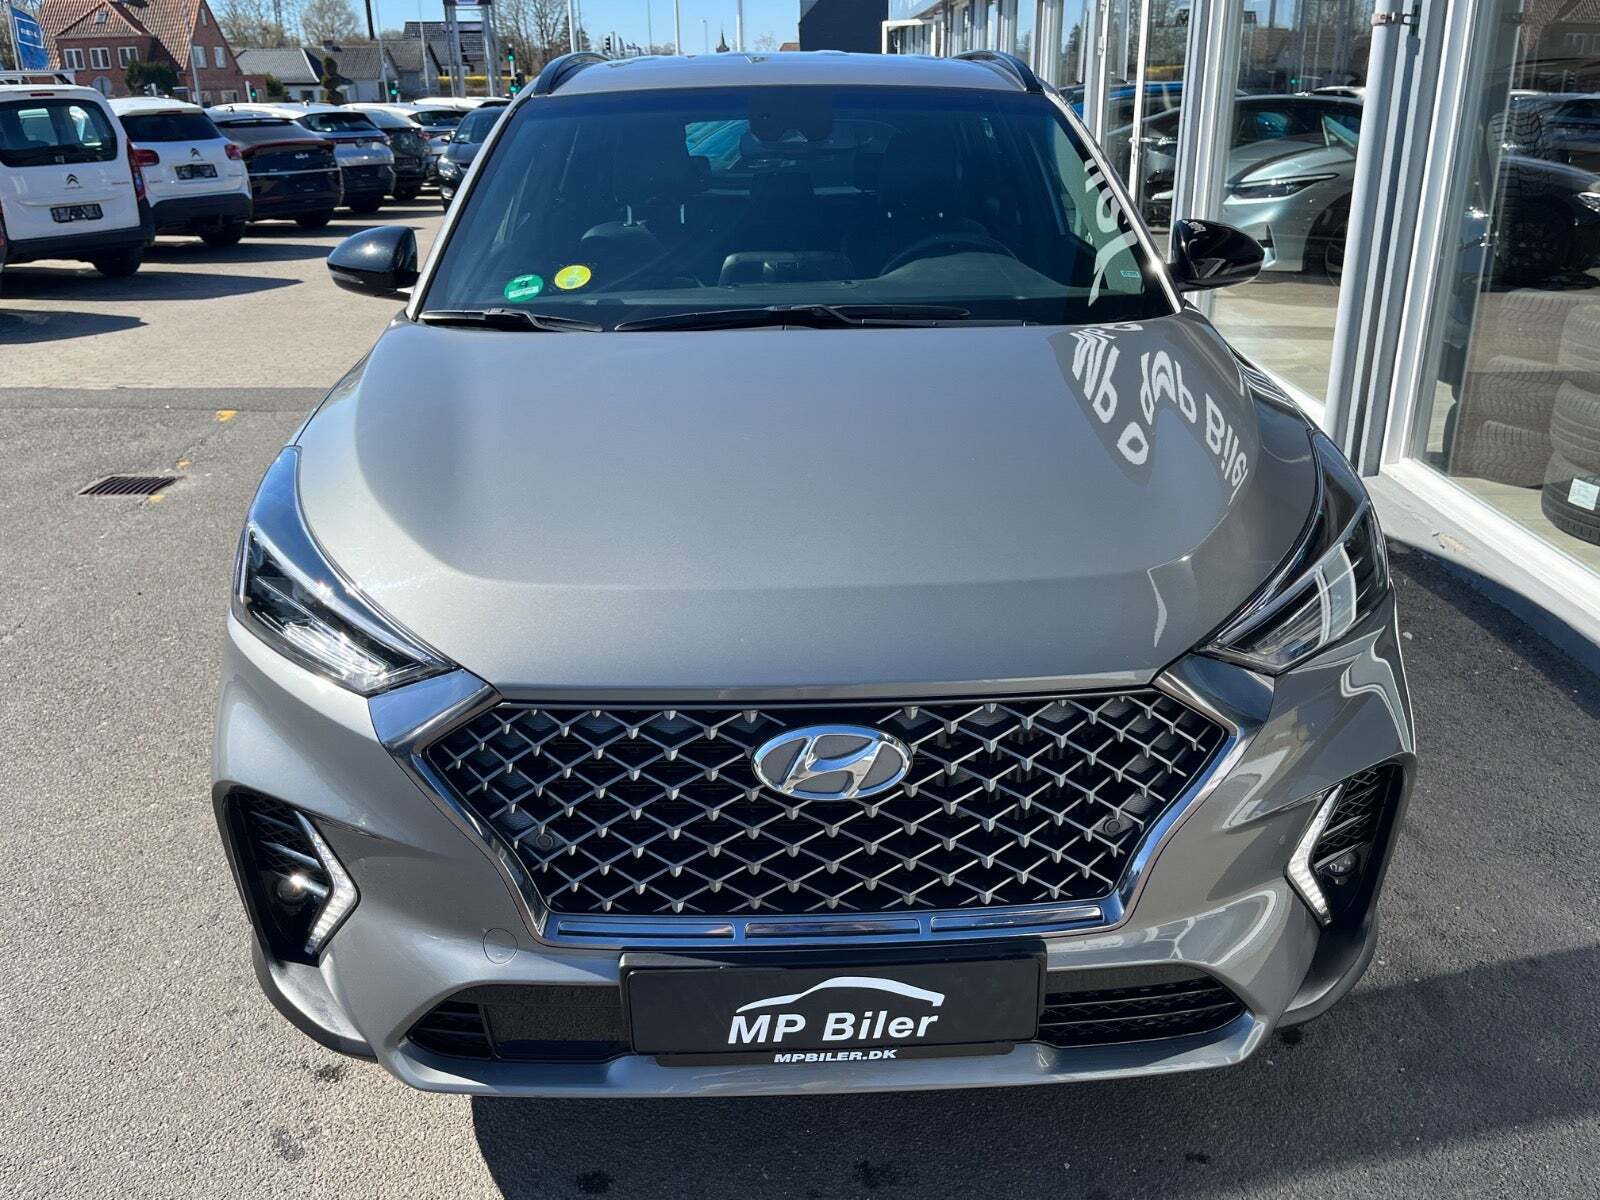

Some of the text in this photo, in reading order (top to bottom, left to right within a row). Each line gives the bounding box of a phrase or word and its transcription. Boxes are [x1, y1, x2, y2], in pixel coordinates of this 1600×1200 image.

[728, 1011, 939, 1044] MP Biler
[774, 1050, 898, 1063] MPBILER.DK
